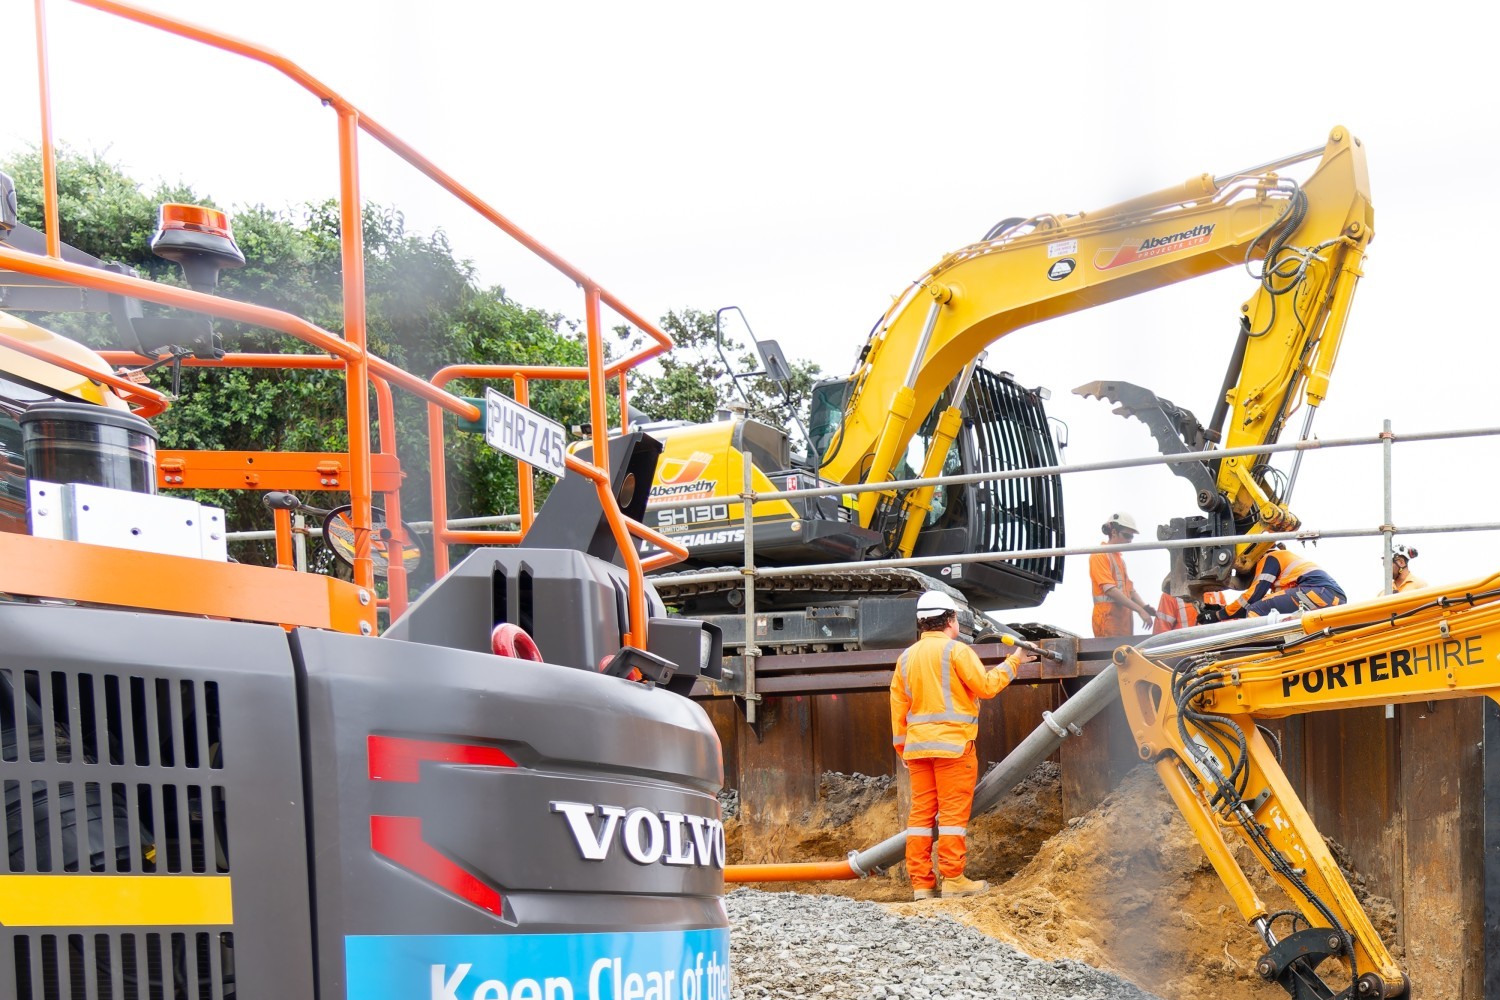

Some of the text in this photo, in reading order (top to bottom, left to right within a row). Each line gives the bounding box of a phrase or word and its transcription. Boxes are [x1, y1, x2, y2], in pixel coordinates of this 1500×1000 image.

[1138, 224, 1216, 252] Abernethy
[1138, 238, 1204, 258] PROJECTS LTD
[491, 400, 562, 468] PHR745
[650, 480, 716, 496] Abernethy
[653, 529, 745, 551] ECIALISTS
[549, 800, 726, 869] VOLVO
